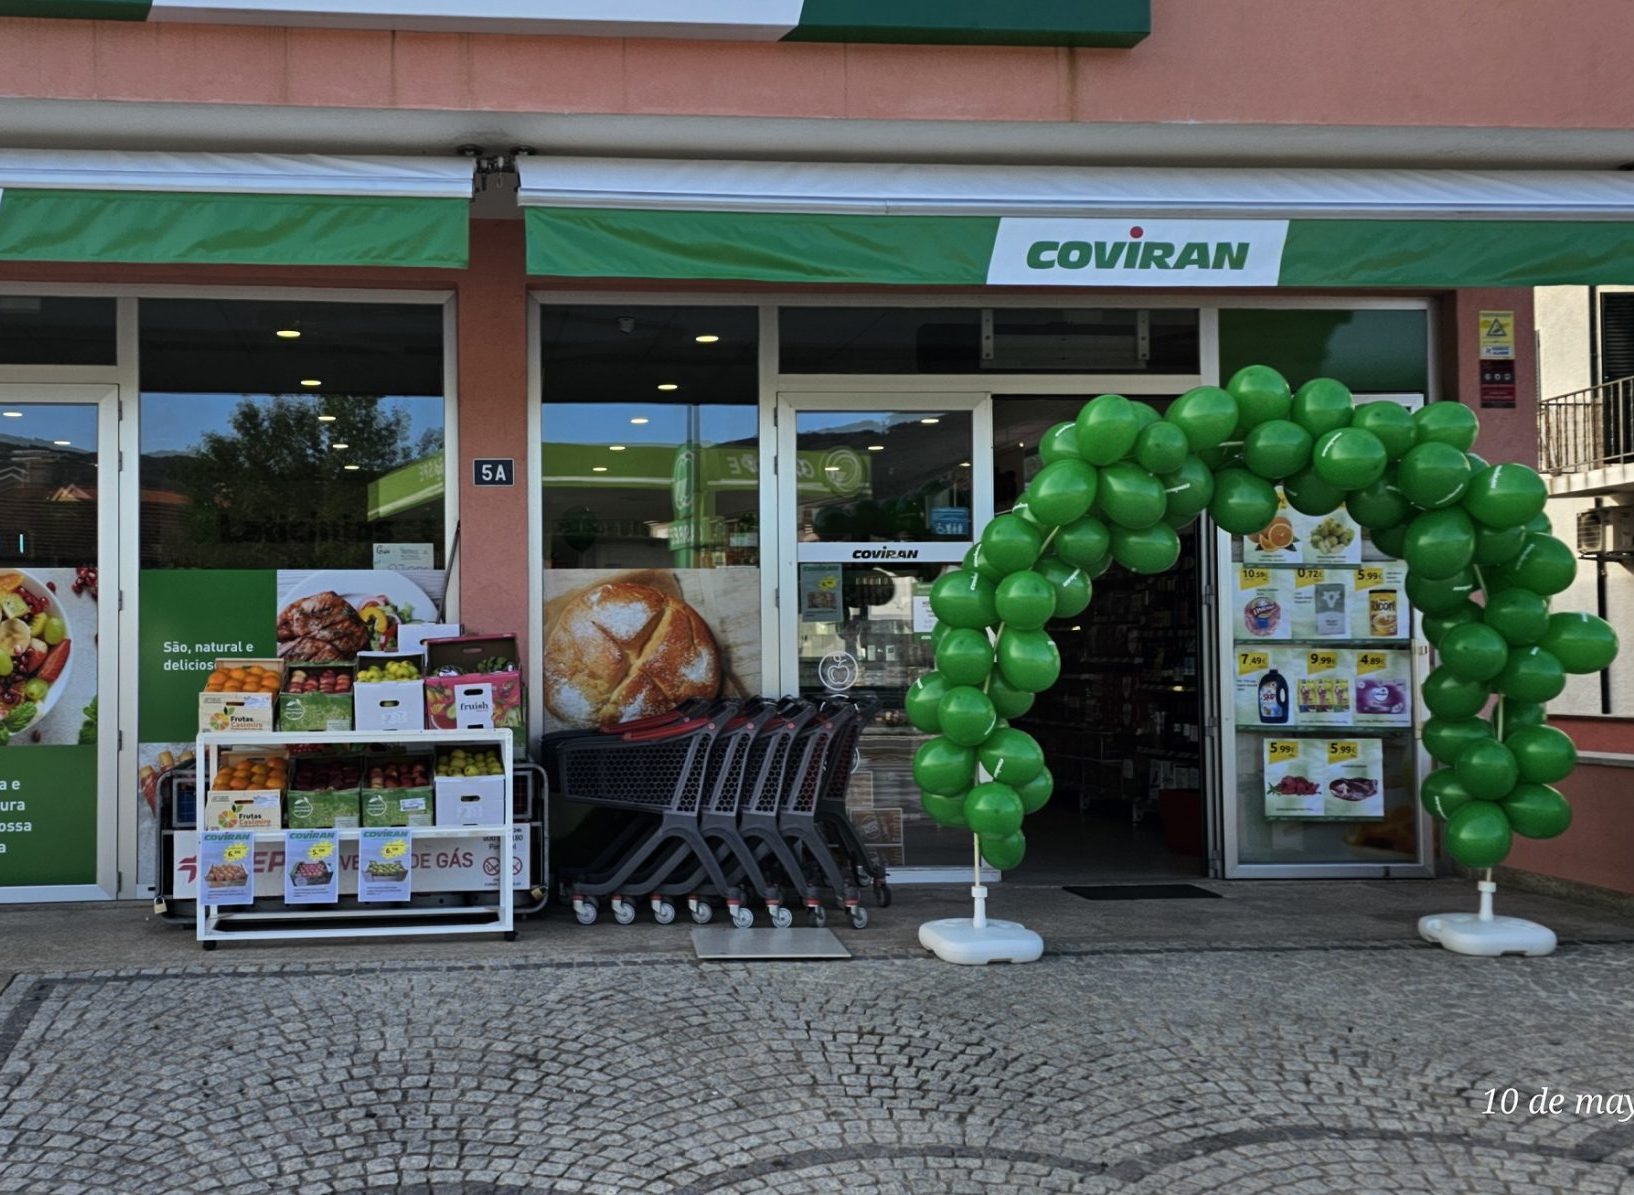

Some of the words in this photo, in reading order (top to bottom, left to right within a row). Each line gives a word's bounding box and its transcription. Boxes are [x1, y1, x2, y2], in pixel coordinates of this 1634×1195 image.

[1026, 226, 1250, 270] COVIRAN
[481, 464, 507, 481] 5A
[852, 545, 919, 559] COVIRAN
[163, 641, 191, 654] São,
[195, 641, 243, 652] natural
[246, 643, 254, 652] e
[460, 701, 489, 711] fruish
[11, 780, 21, 790] e
[204, 831, 250, 841] COVIRAN
[289, 830, 335, 840] COVIRAN
[363, 829, 409, 839] COVIRAN
[436, 847, 474, 868] GÁS
